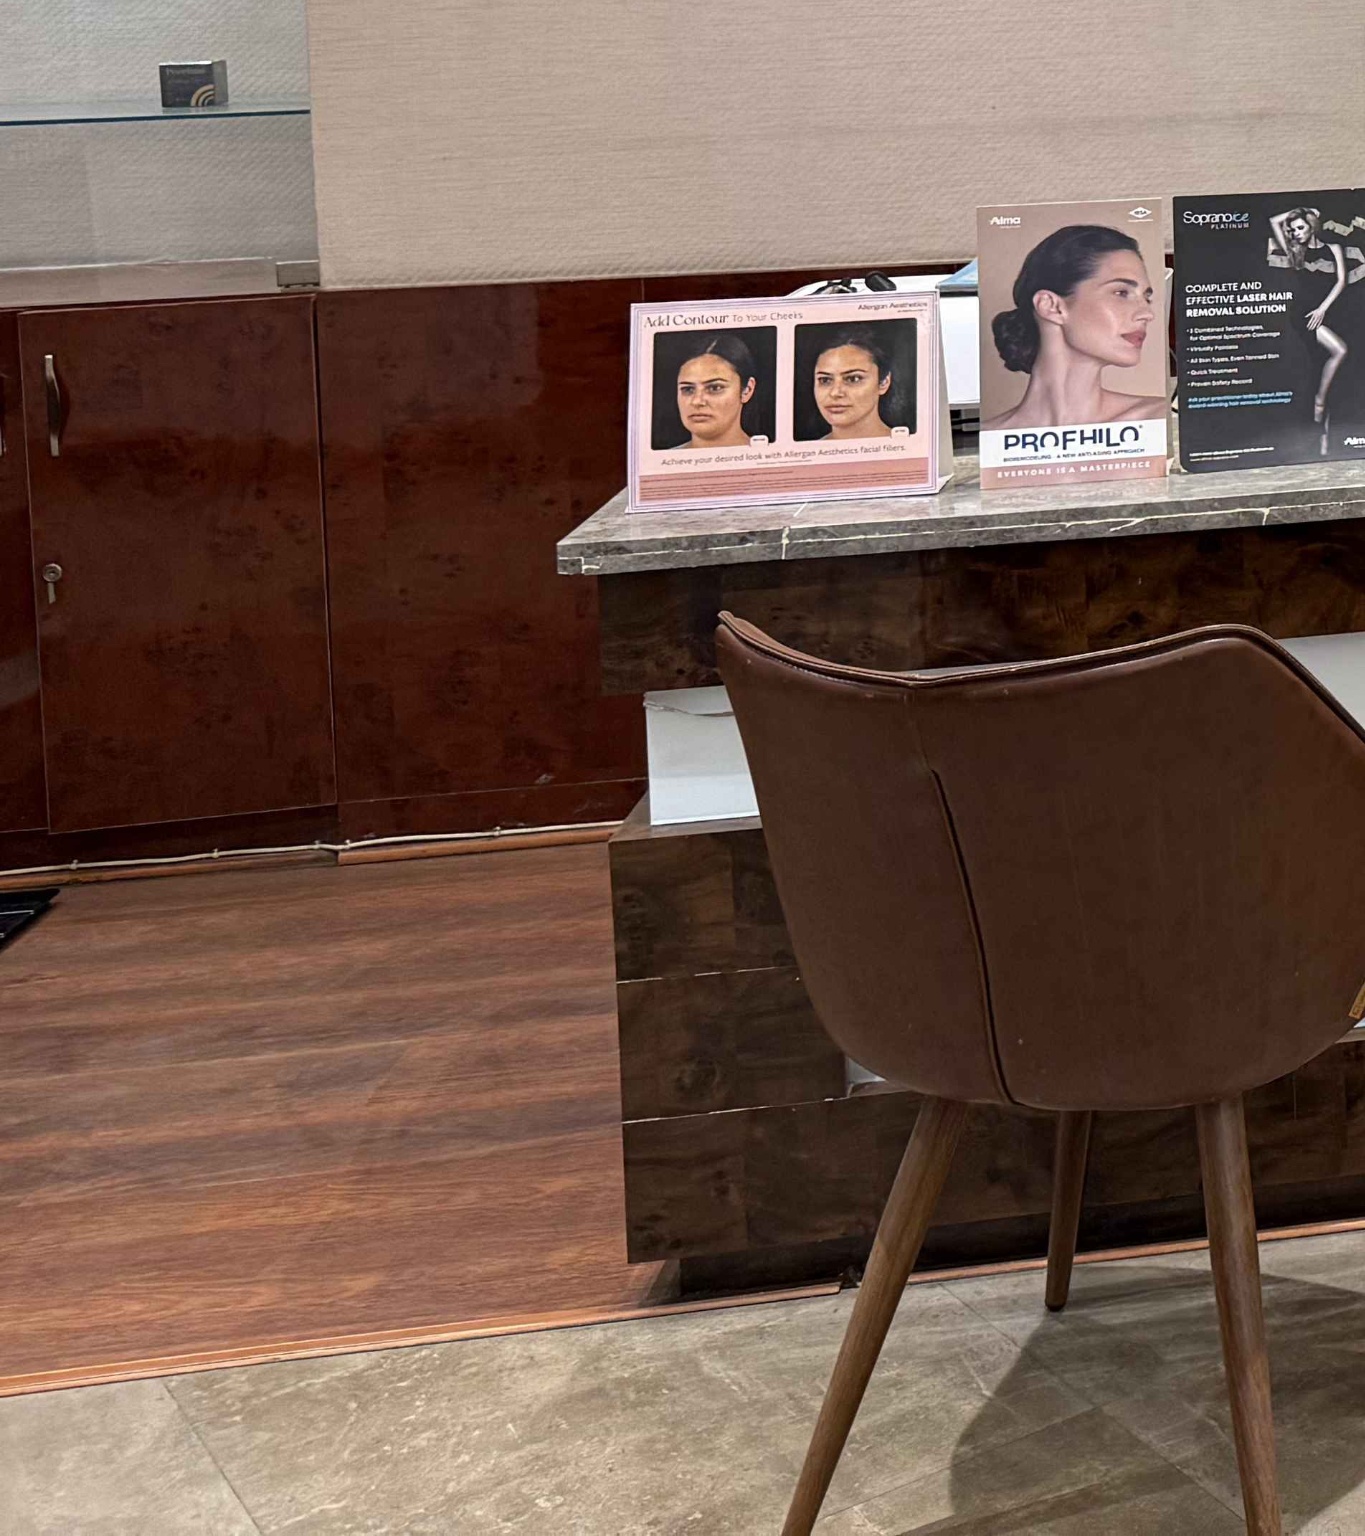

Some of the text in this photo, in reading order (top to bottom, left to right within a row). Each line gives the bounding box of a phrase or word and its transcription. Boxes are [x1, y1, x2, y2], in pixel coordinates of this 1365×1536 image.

[989, 215, 1021, 226] Alma
[1210, 222, 1250, 230] PLATINUM
[1185, 281, 1262, 293] COMPLETE AND
[1186, 292, 1293, 305] EFFECTIVE LASER HAIR
[1186, 304, 1287, 317] REMOVAL SOLUTION
[644, 312, 803, 328] Add Contour To Your Cheeks
[661, 458, 692, 466] Achieve
[694, 456, 713, 466] your
[714, 454, 744, 463] desired
[746, 453, 762, 461] look
[785, 449, 816, 459] Allergan
[818, 447, 858, 456] Aesthetics
[860, 444, 881, 453] facial
[997, 460, 1151, 479] EVERYONE IS A MASTERPIECE
